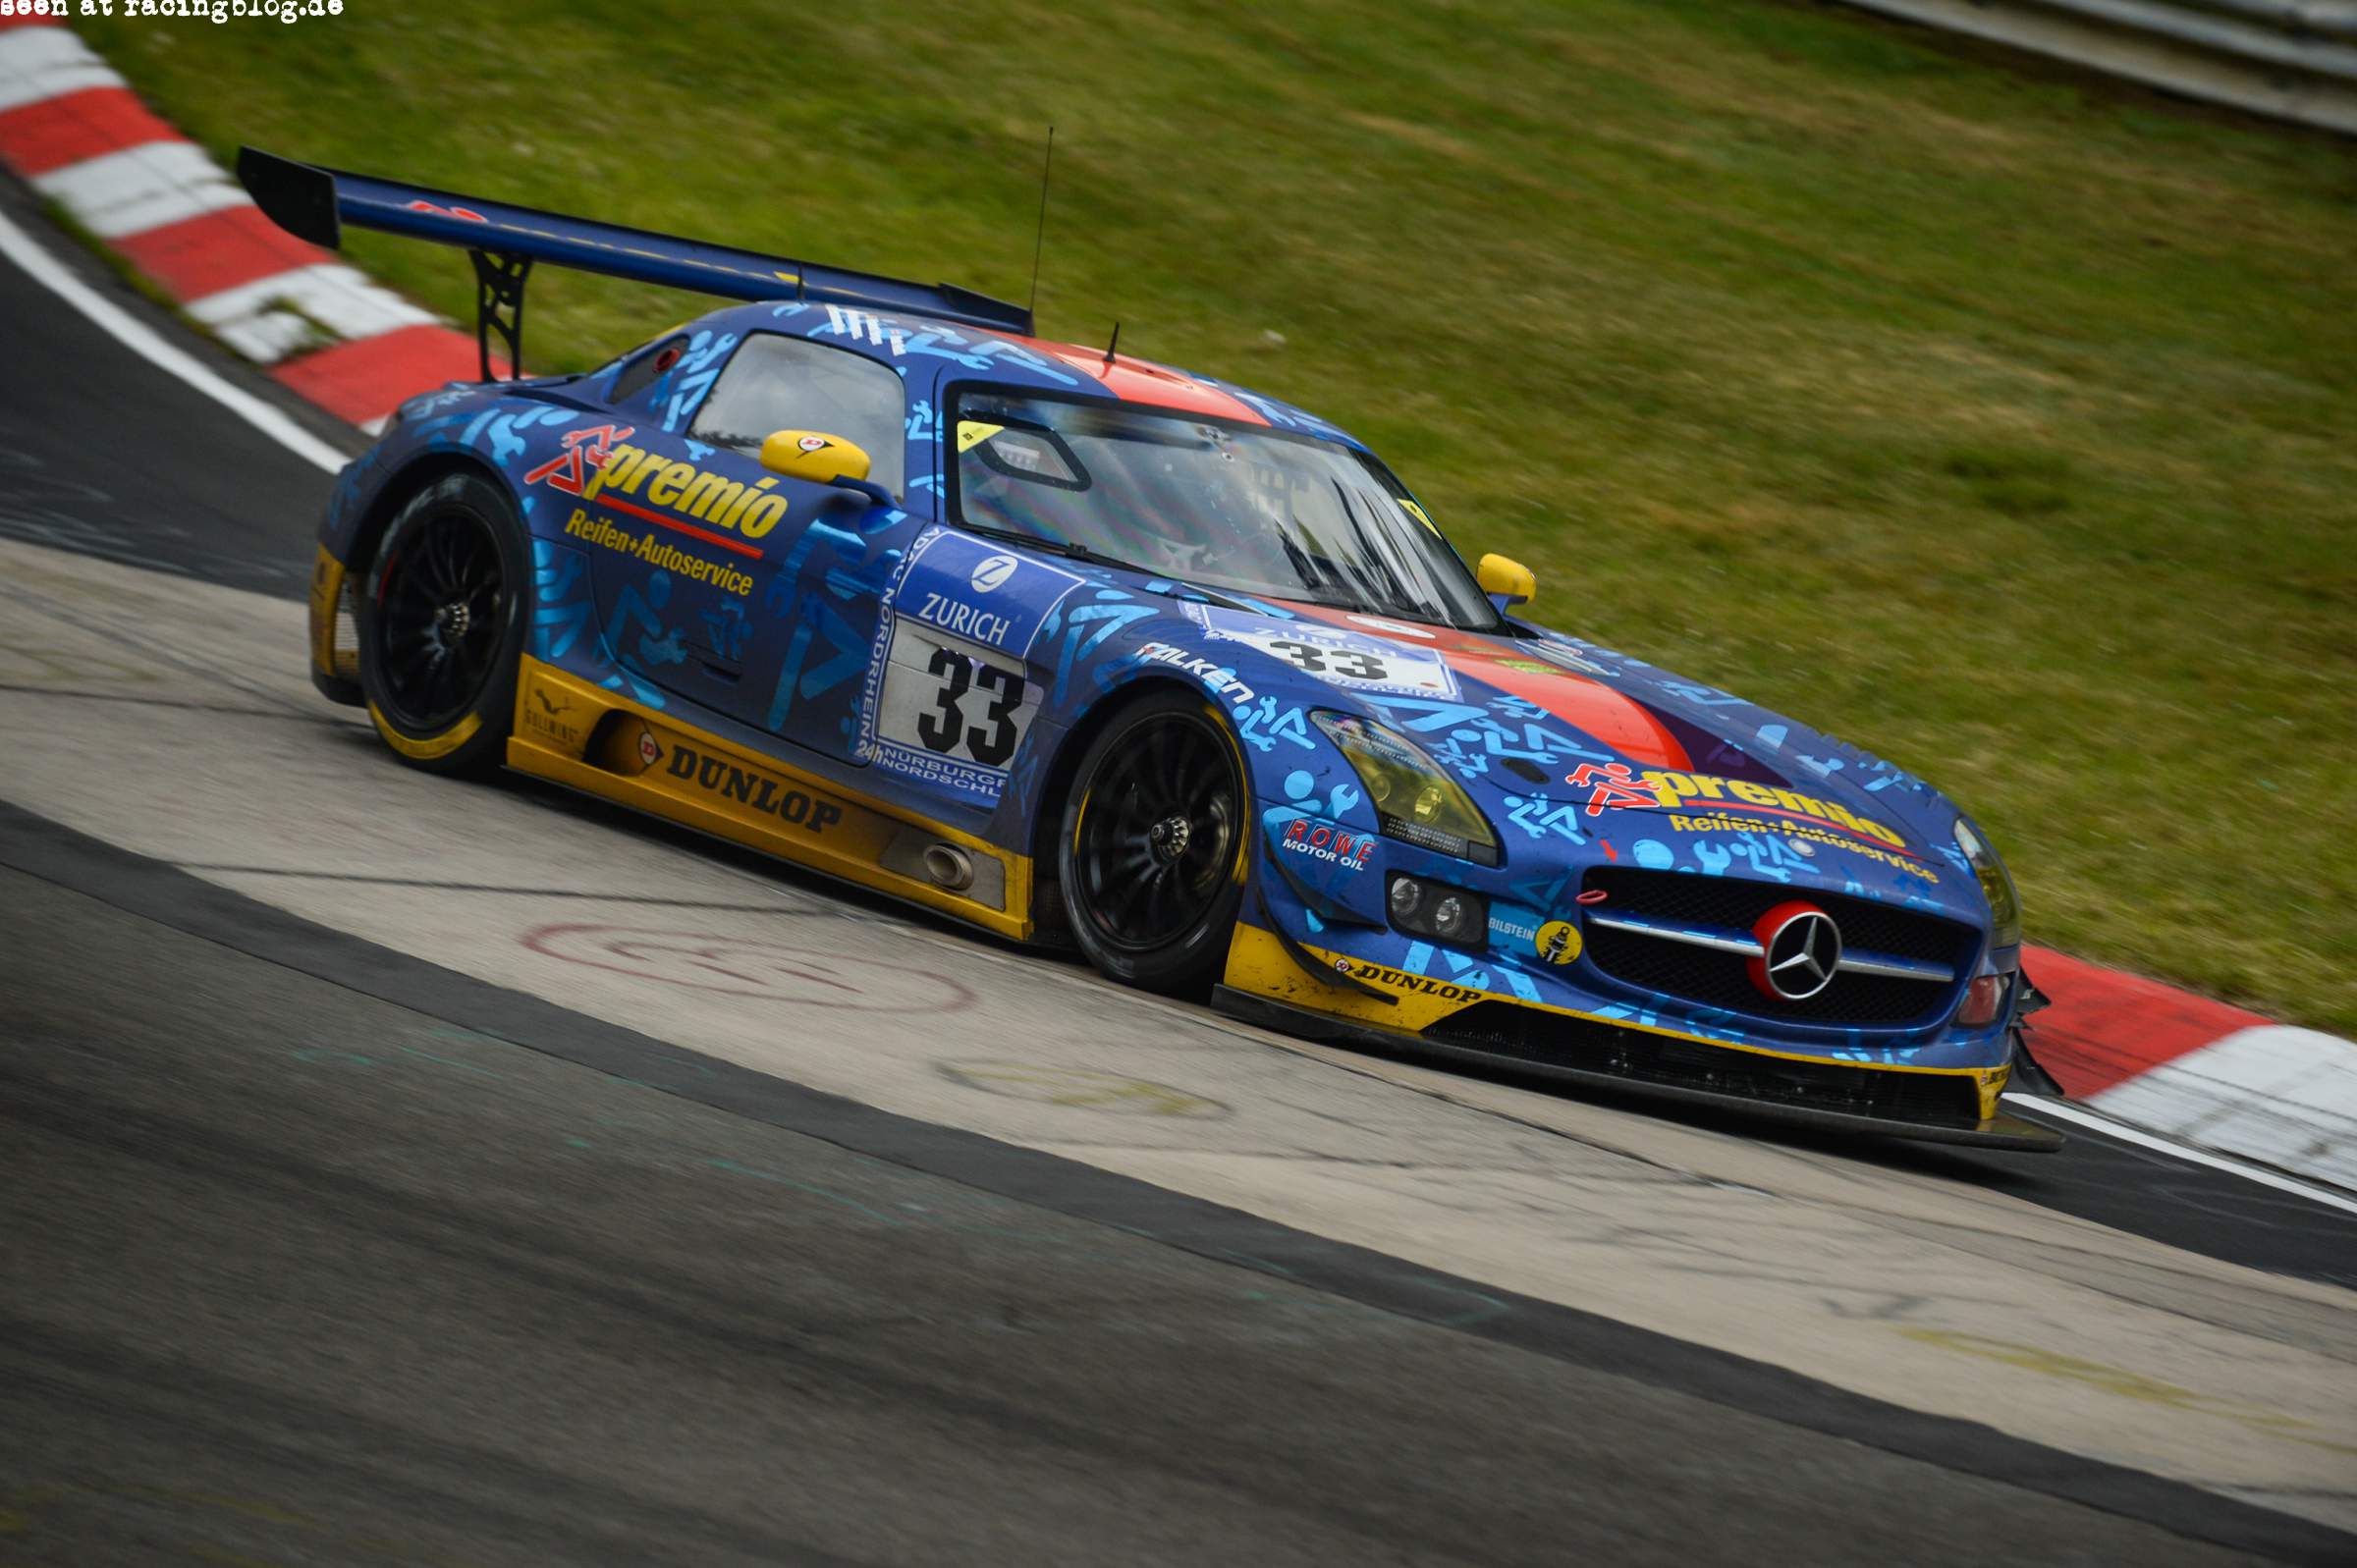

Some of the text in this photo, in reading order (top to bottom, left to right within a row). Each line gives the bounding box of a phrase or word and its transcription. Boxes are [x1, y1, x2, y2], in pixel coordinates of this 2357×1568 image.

[565, 509, 753, 597] Reifen+Autoservice
[918, 592, 1010, 645] ZURICH
[859, 587, 896, 740] NORDRHEIN
[1270, 640, 1388, 680] 33
[917, 647, 1024, 766] 33
[854, 739, 883, 764] 24h
[668, 744, 842, 834] DUNLOP
[883, 757, 1001, 797] NORDSCHL
[1641, 771, 1906, 848] premio
[1282, 838, 1365, 872] MOTOR OIL
[1285, 818, 1377, 863] ROWE
[1671, 811, 1941, 884] Reifen+Autoservice
[1488, 916, 1535, 941] BILSTEIN
[1354, 964, 1482, 1003] DUNLOP
